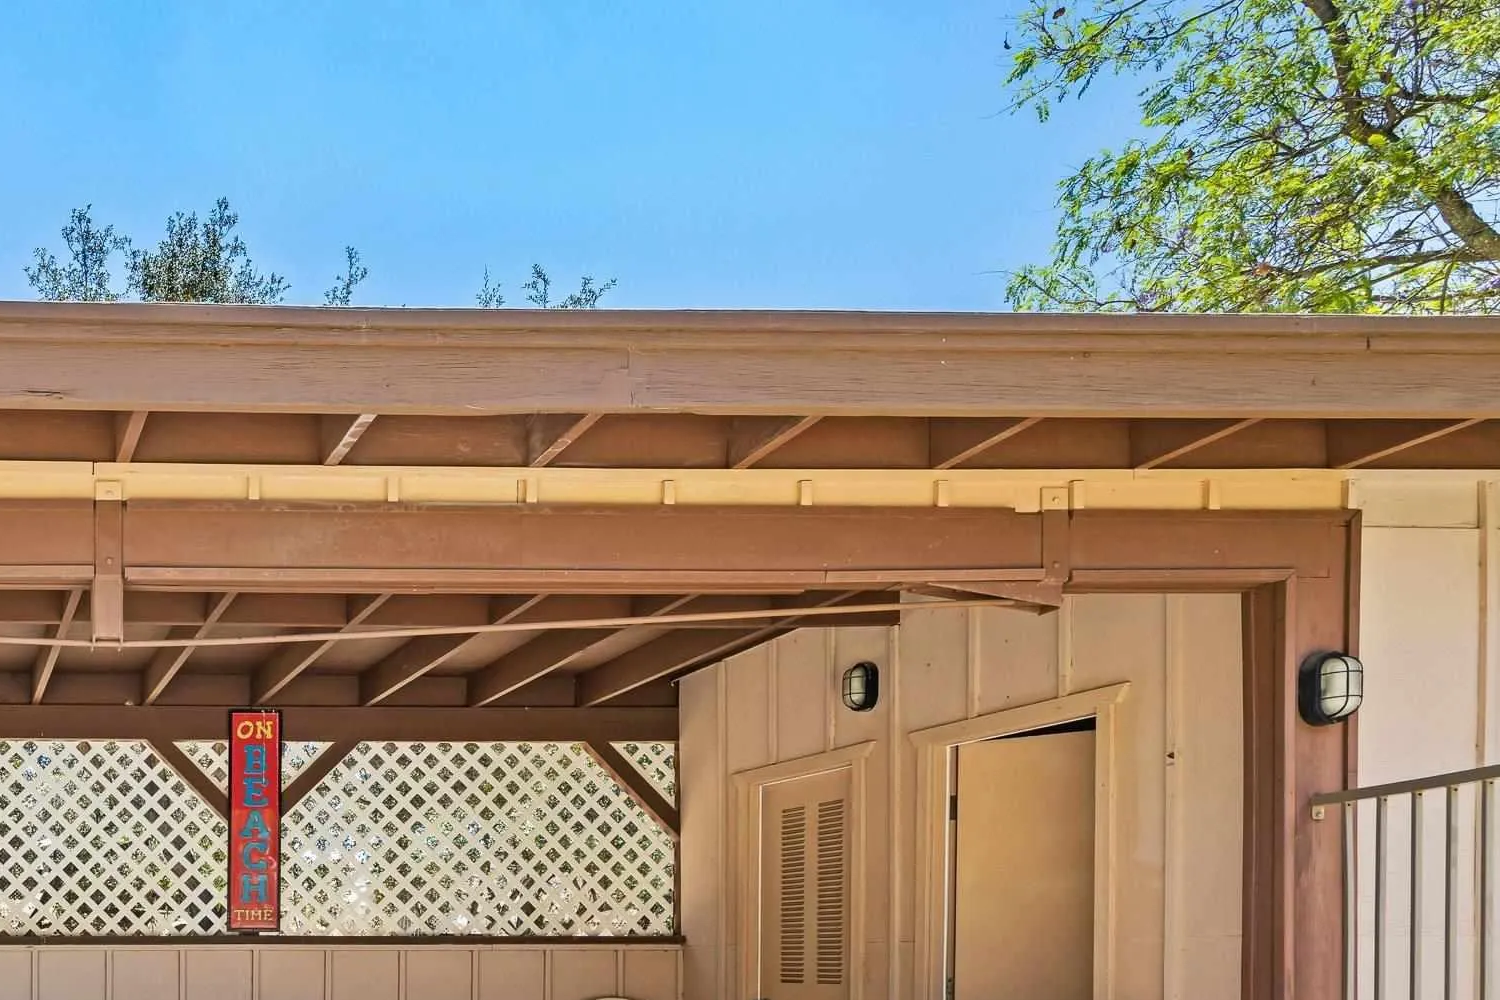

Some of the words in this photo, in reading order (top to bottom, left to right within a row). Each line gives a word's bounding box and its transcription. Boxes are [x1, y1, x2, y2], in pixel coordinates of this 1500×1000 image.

[236, 720, 274, 740] ON
[239, 744, 270, 904] BEACH
[233, 909, 274, 922] TIME
